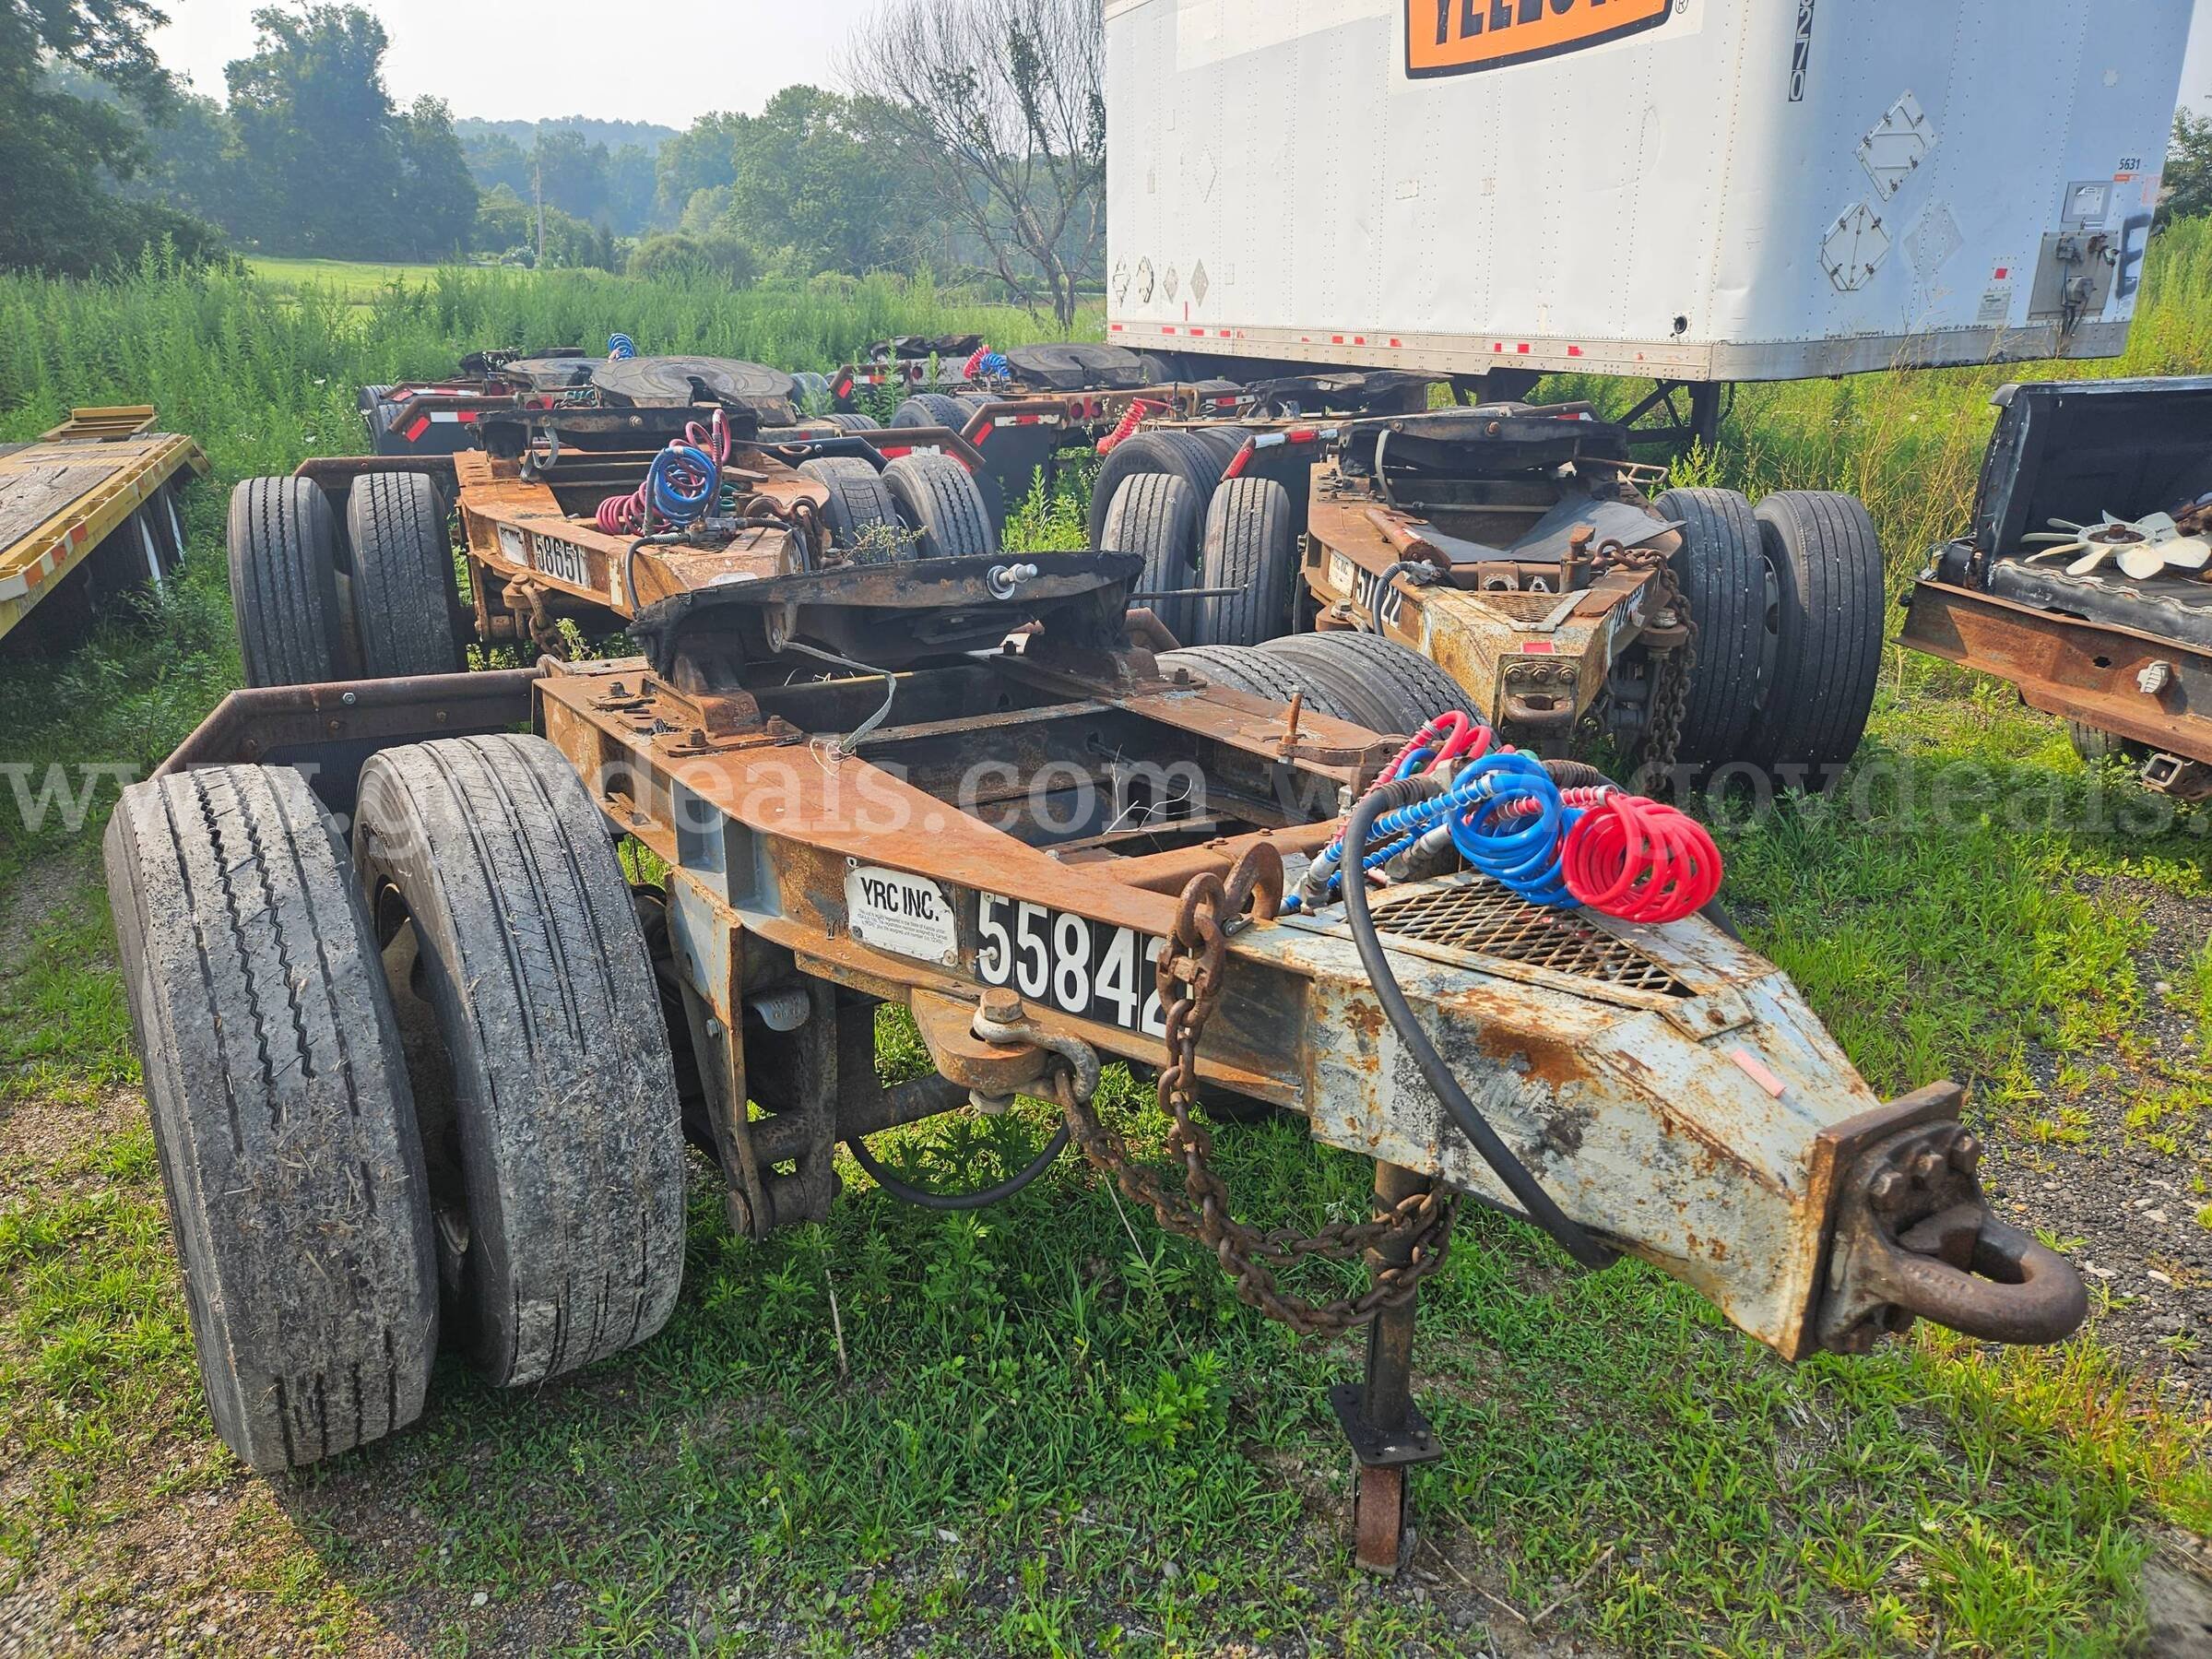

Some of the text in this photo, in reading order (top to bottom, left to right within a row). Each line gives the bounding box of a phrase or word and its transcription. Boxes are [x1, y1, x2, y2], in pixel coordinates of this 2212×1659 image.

[2118, 158, 2141, 170] 5631
[860, 876, 940, 922] YRC INC.
